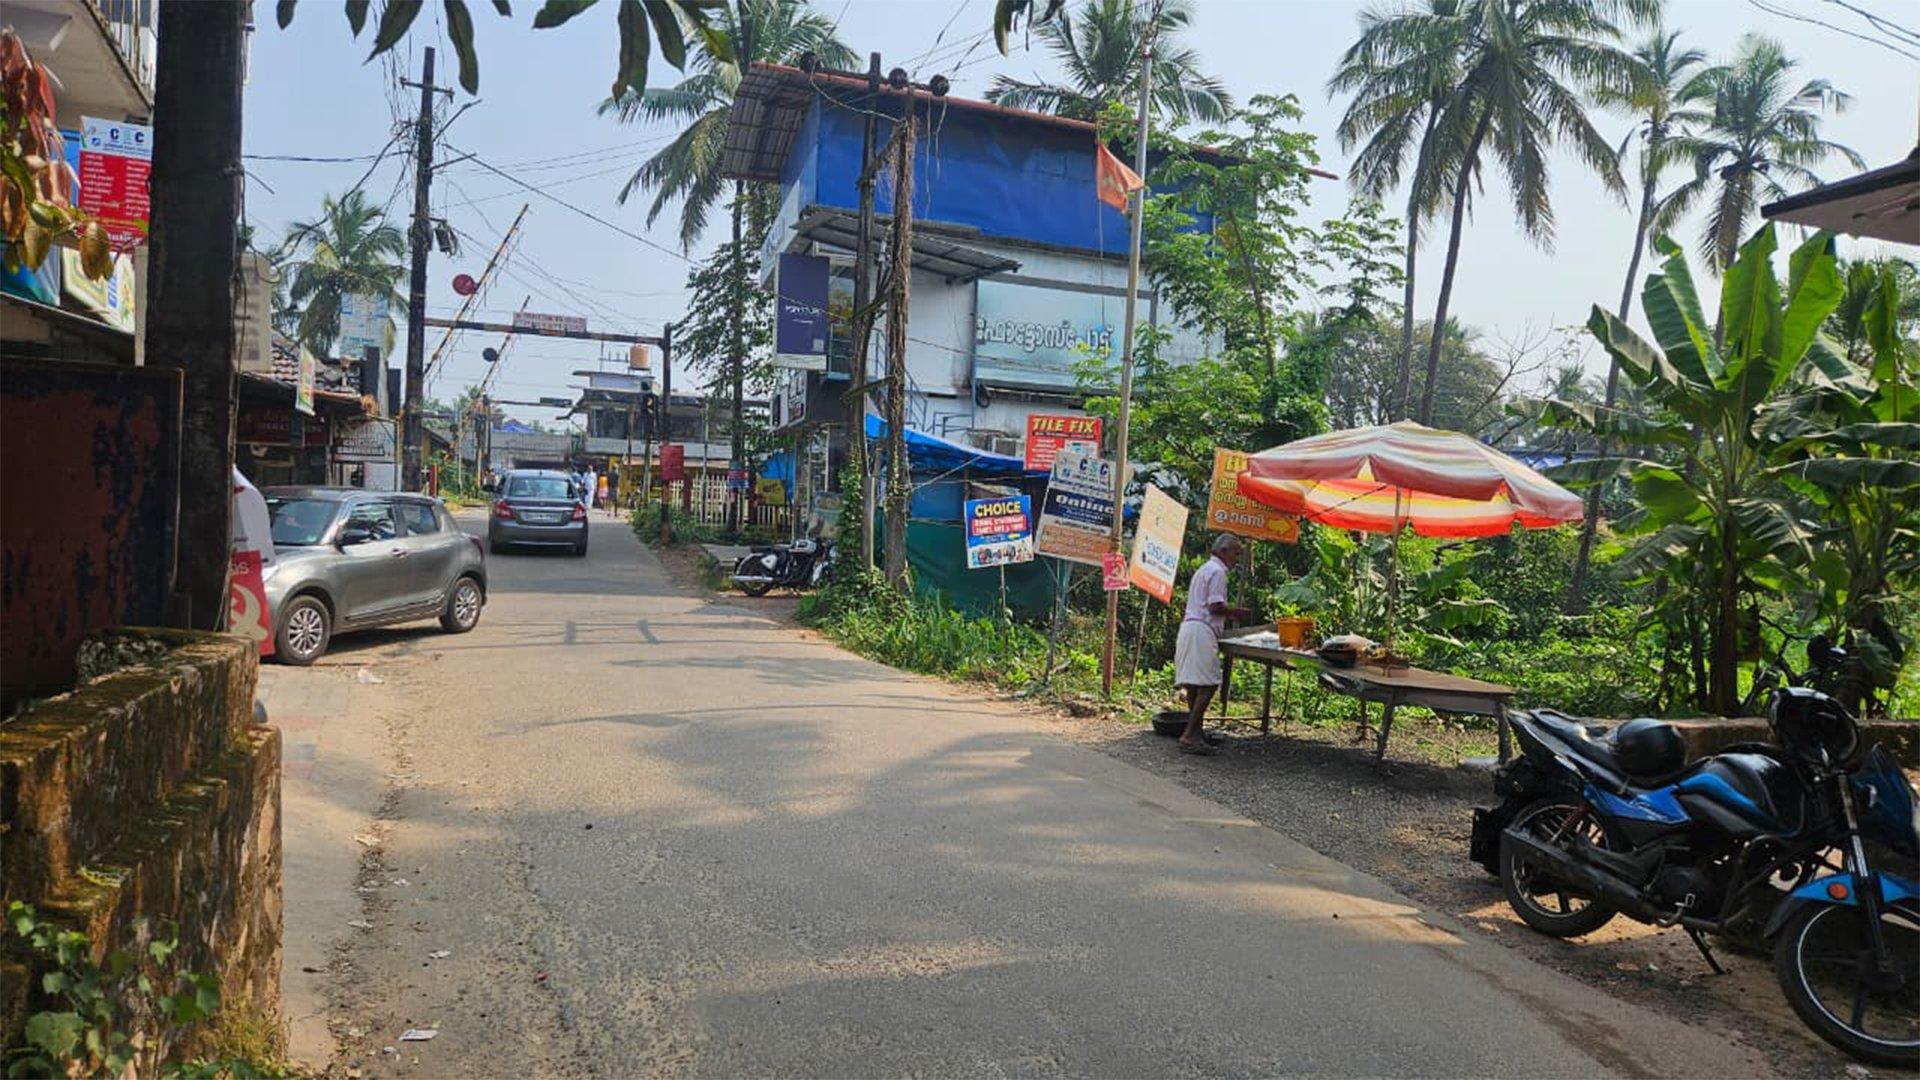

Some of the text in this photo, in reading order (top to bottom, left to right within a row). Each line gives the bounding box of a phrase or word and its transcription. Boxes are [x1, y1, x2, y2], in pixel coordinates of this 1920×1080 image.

[1032, 418, 1095, 433] TILE FIX
[975, 501, 1021, 517] CHOICE
